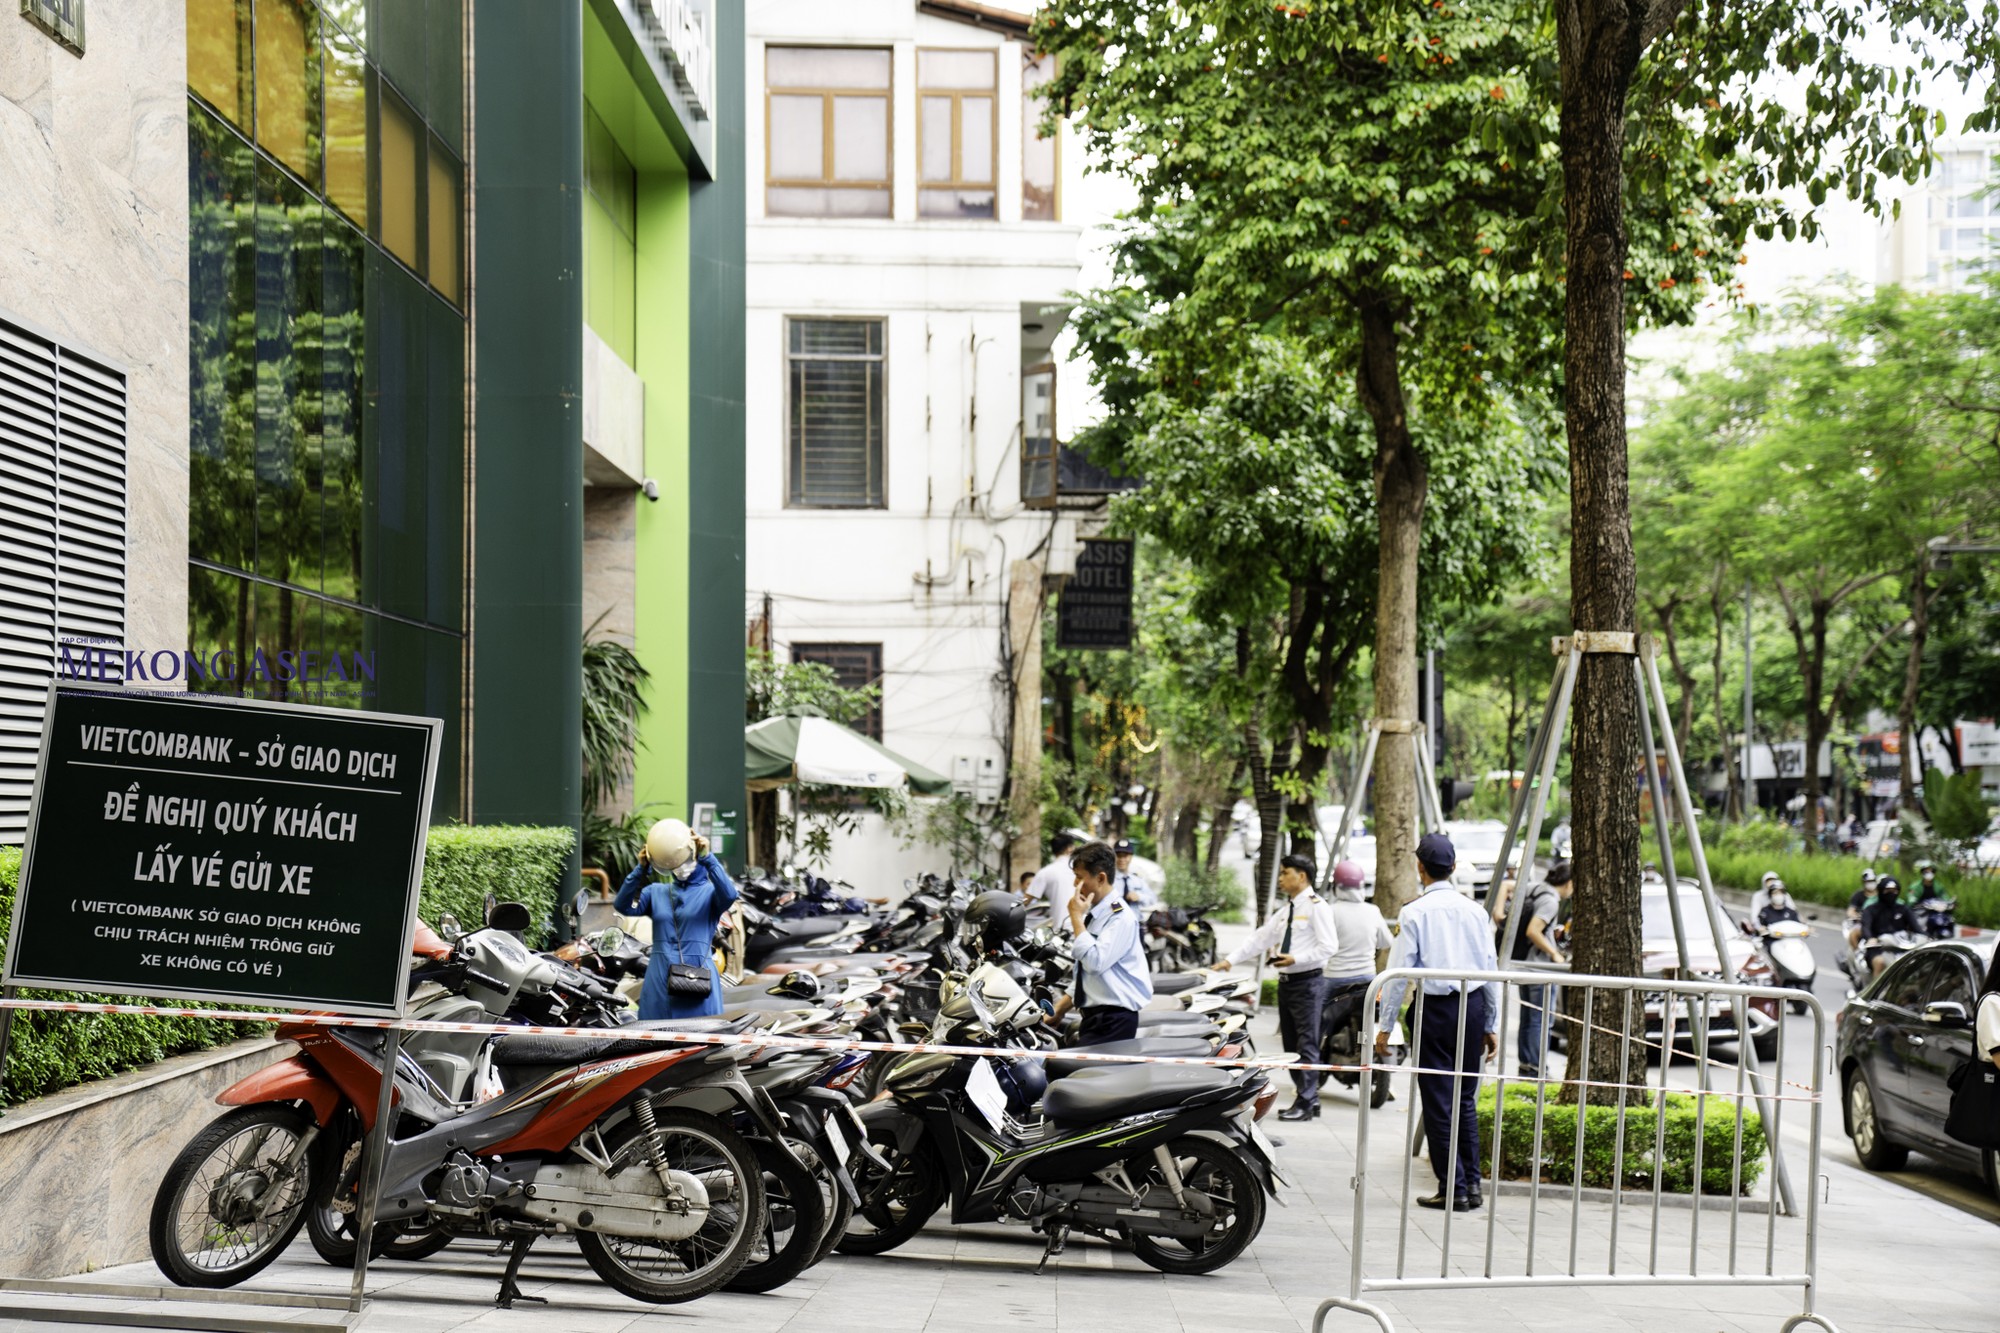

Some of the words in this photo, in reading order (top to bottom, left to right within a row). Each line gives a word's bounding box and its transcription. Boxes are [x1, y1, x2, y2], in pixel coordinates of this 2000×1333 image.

[81, 725, 232, 762] VIETCOMBANK
[256, 734, 285, 767] SỞ
[291, 745, 340, 772] GIAO
[347, 751, 396, 781] DỊCH
[104, 782, 140, 822] ĐỀ
[145, 795, 206, 834] NGHỊ
[215, 798, 267, 836] QUÝ
[273, 803, 357, 841] KHÁCH
[134, 843, 183, 884] LẤY
[192, 851, 223, 887] VÉ
[230, 851, 272, 891] GỬI
[278, 865, 313, 895] XE
[82, 901, 193, 921] VIETCOMBANK
[199, 907, 220, 922] SỞ
[224, 913, 261, 926] GIAO
[266, 915, 302, 931] DỊCH
[308, 917, 361, 935] KHÔNG
[94, 925, 132, 942] CHỊU
[137, 927, 189, 946] TRÁCH
[195, 932, 244, 951] NHIỆM
[250, 936, 302, 954] TRÔNG
[308, 940, 335, 956] GIỮ
[140, 954, 162, 967] XE
[166, 953, 221, 972] KHÔNG
[227, 957, 247, 973] CÓ
[253, 960, 272, 976] VÉ
